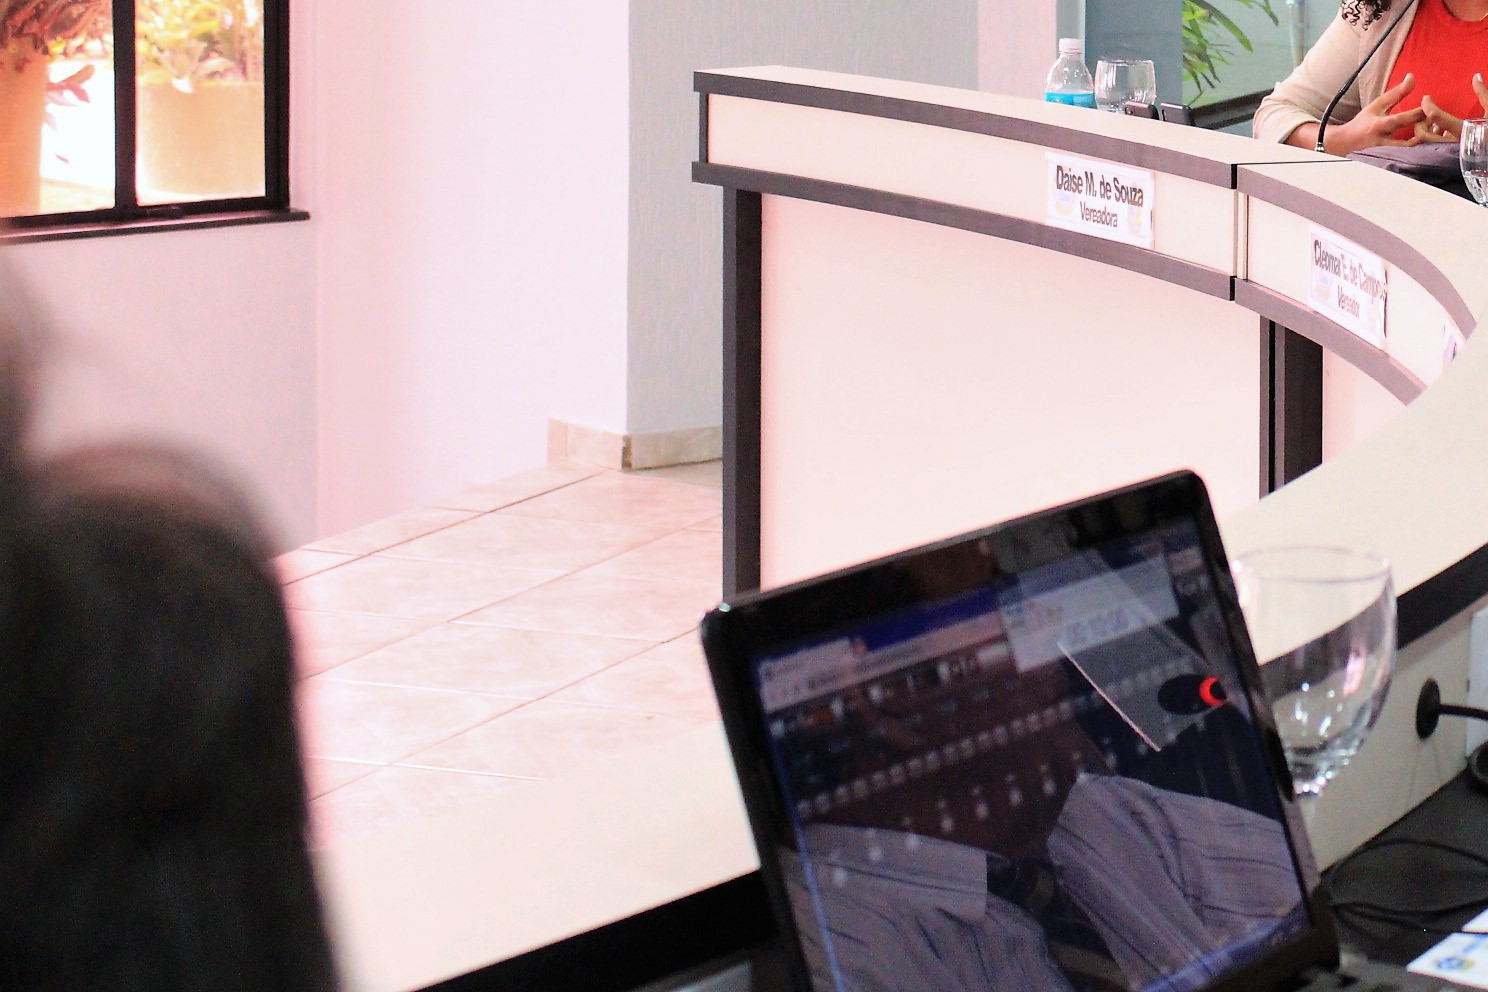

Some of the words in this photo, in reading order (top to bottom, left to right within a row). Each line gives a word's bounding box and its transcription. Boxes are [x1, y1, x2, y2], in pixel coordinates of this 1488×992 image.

[1056, 165, 1083, 194] Daise
[1085, 171, 1097, 198] M.
[1100, 175, 1111, 200] de
[1113, 177, 1144, 207] Souza
[1080, 201, 1118, 228] Vereadora
[1314, 239, 1341, 278] Cleomar
[1350, 259, 1358, 286] de
[1337, 285, 1360, 318] Vereador
